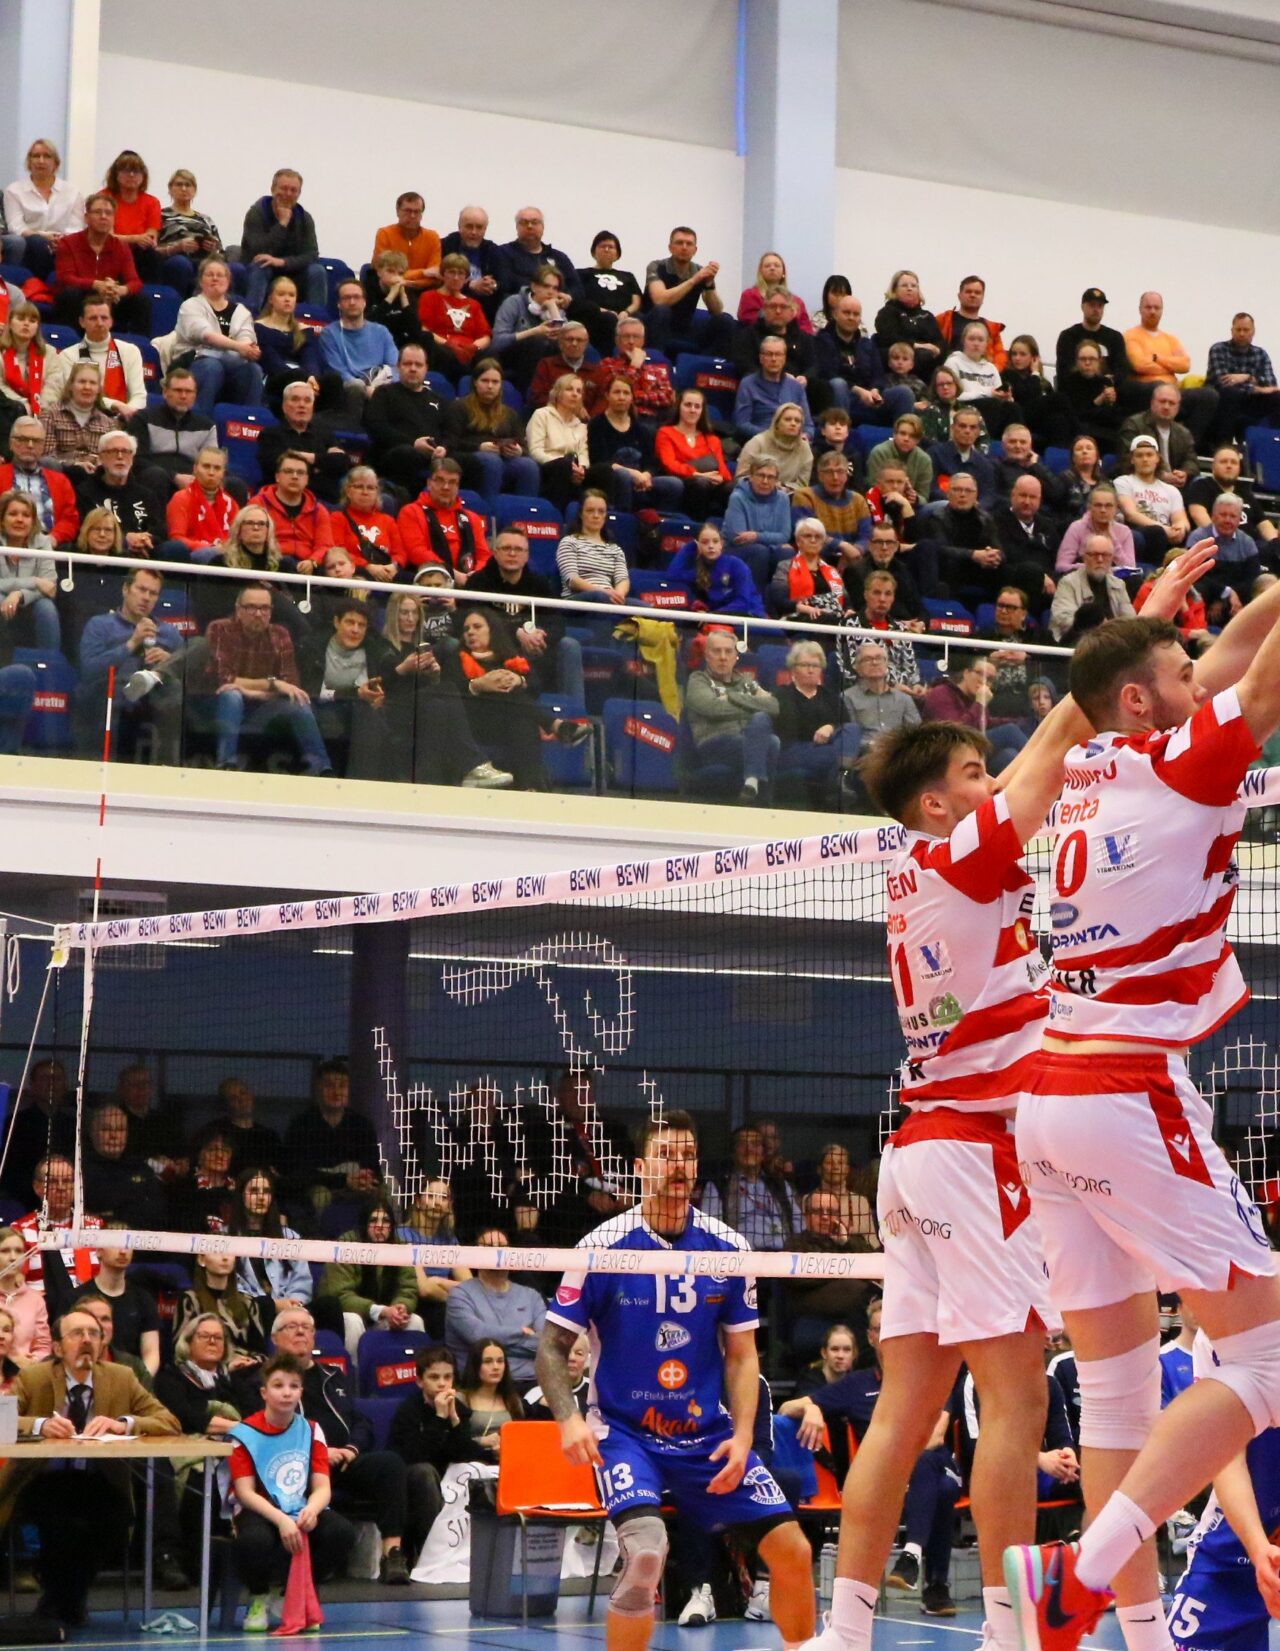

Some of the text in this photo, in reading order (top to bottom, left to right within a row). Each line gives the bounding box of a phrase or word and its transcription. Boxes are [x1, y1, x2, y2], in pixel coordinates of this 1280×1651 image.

[1060, 798, 1100, 825] enta
[279, 902, 304, 924] BEWI
[314, 899, 341, 920] BEWI
[353, 895, 380, 917] BEWI
[392, 889, 420, 912] BEWI
[430, 884, 460, 908] BEWI
[472, 879, 503, 904] BEWI
[516, 874, 547, 898] BEWI
[569, 867, 601, 891] BEWI
[616, 862, 650, 887] BEWI
[666, 855, 700, 882] BEWI
[714, 847, 750, 875] BEWI
[765, 839, 803, 867] BEWI
[820, 832, 859, 859] BEWI
[603, 1462, 634, 1498] 13
